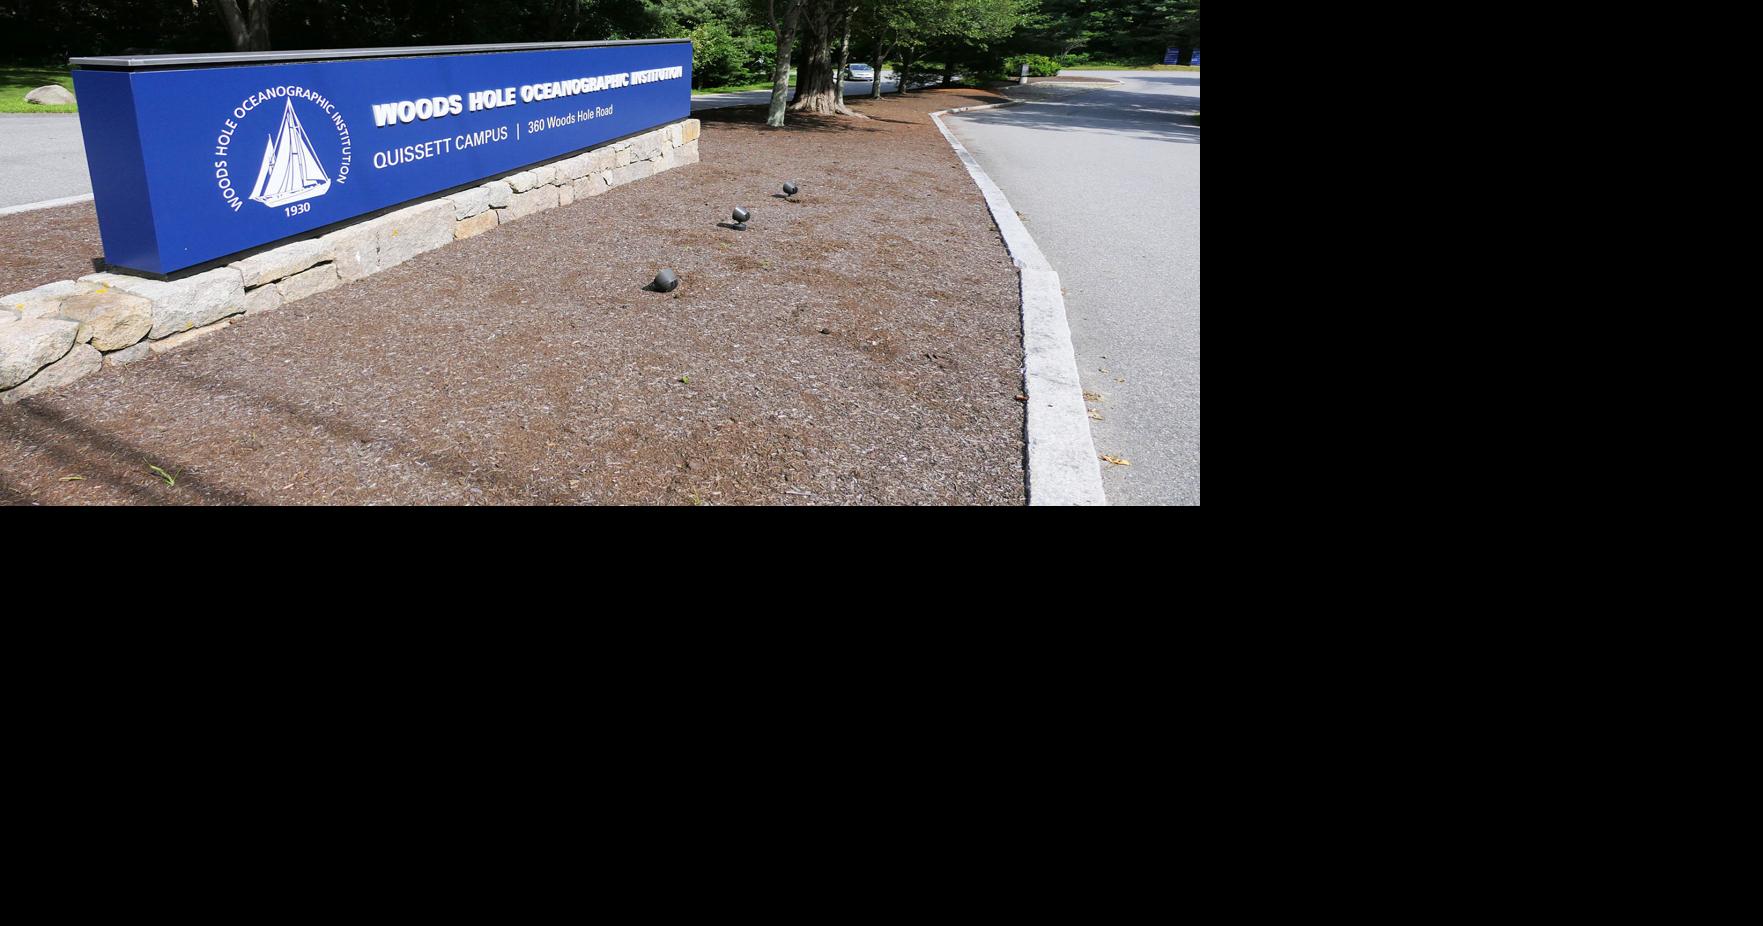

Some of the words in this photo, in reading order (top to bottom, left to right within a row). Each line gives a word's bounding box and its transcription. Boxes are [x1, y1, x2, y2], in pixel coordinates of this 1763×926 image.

[234, 85, 335, 119] OCEANOGRAPHIC
[373, 95, 463, 127] WOODS
[469, 87, 516, 112] HOLE
[520, 73, 630, 103] OCEANOGRAPHIC
[631, 66, 683, 86] INSTITUTION
[215, 118, 238, 156] HOLE
[331, 112, 352, 184] INSTITUTION
[373, 138, 452, 169] QUISSETT
[455, 126, 508, 150] CAMPUS
[528, 119, 545, 134] 360
[547, 113, 576, 130] Woods
[577, 107, 594, 122] Hole
[595, 104, 613, 118] Road
[215, 160, 243, 212] WOODS
[284, 202, 311, 218] 1930
